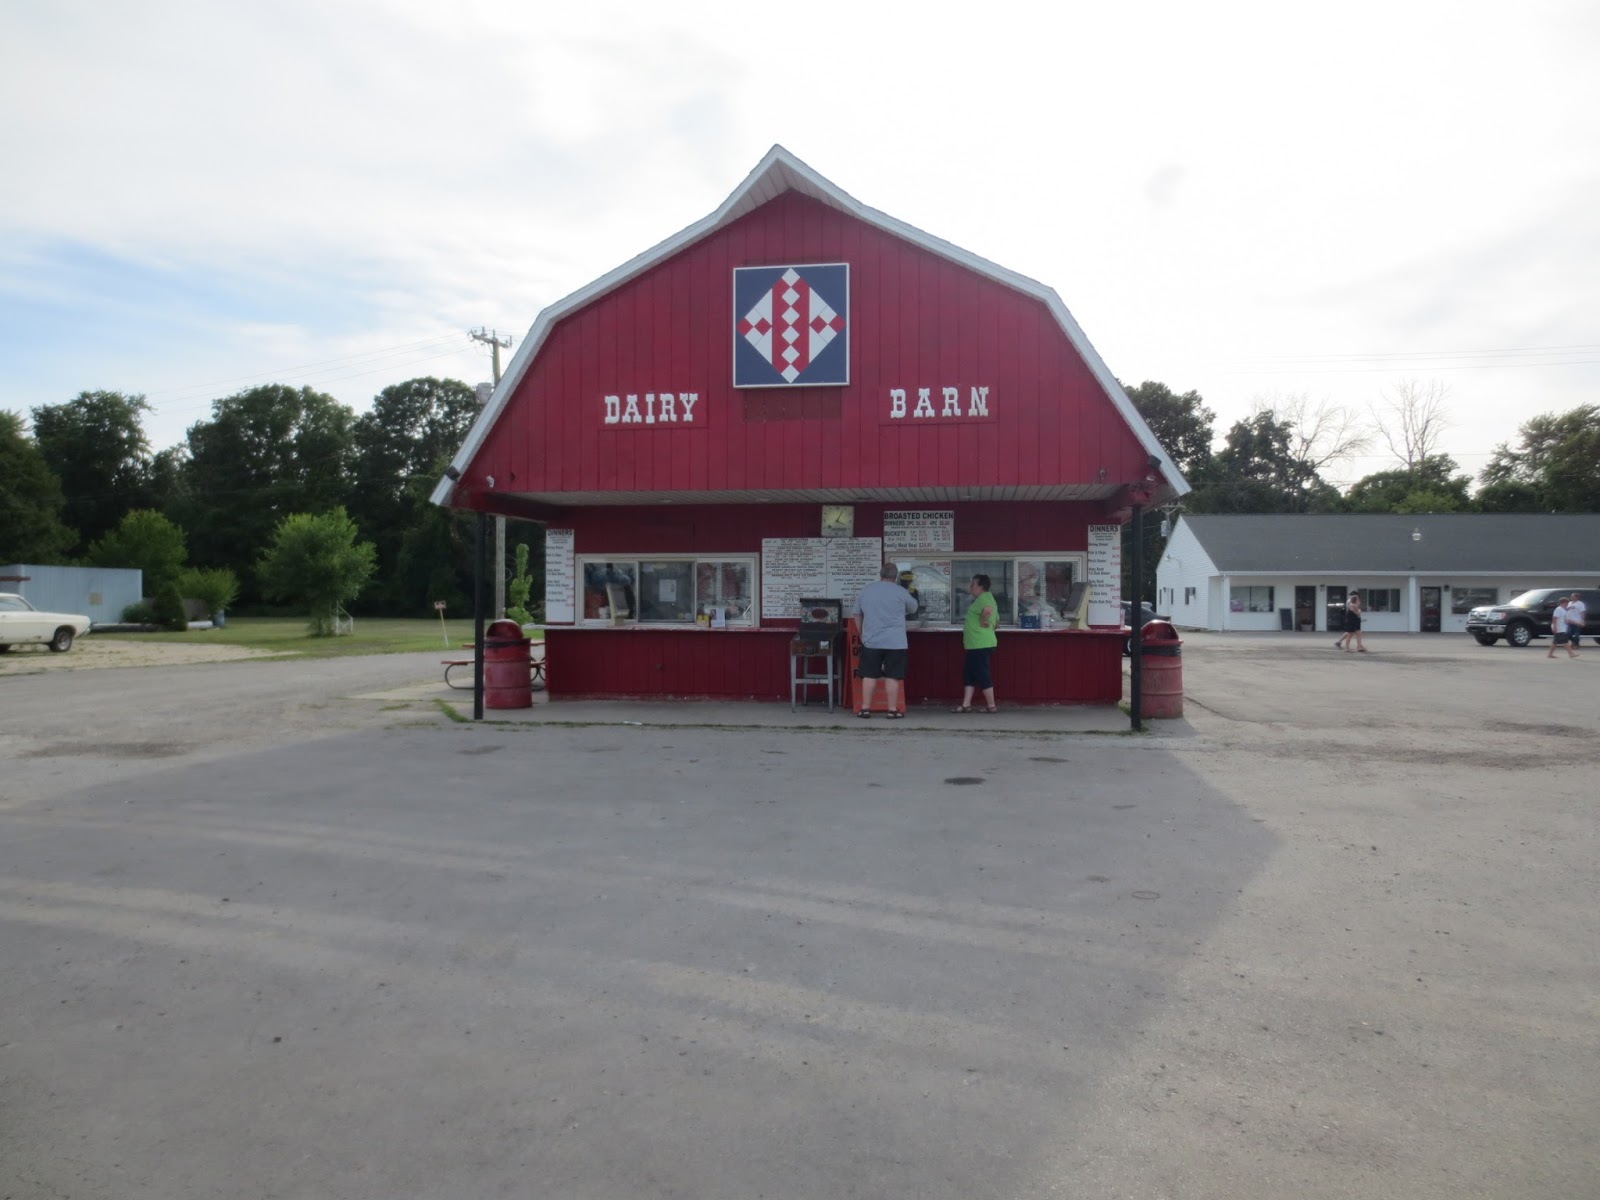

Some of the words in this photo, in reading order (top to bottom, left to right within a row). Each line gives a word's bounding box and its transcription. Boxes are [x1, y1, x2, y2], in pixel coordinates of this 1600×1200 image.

[604, 393, 698, 424] DAIRY
[890, 386, 989, 418] BARN
[884, 512, 920, 520] BROASTED
[922, 512, 954, 520] CHICKEN
